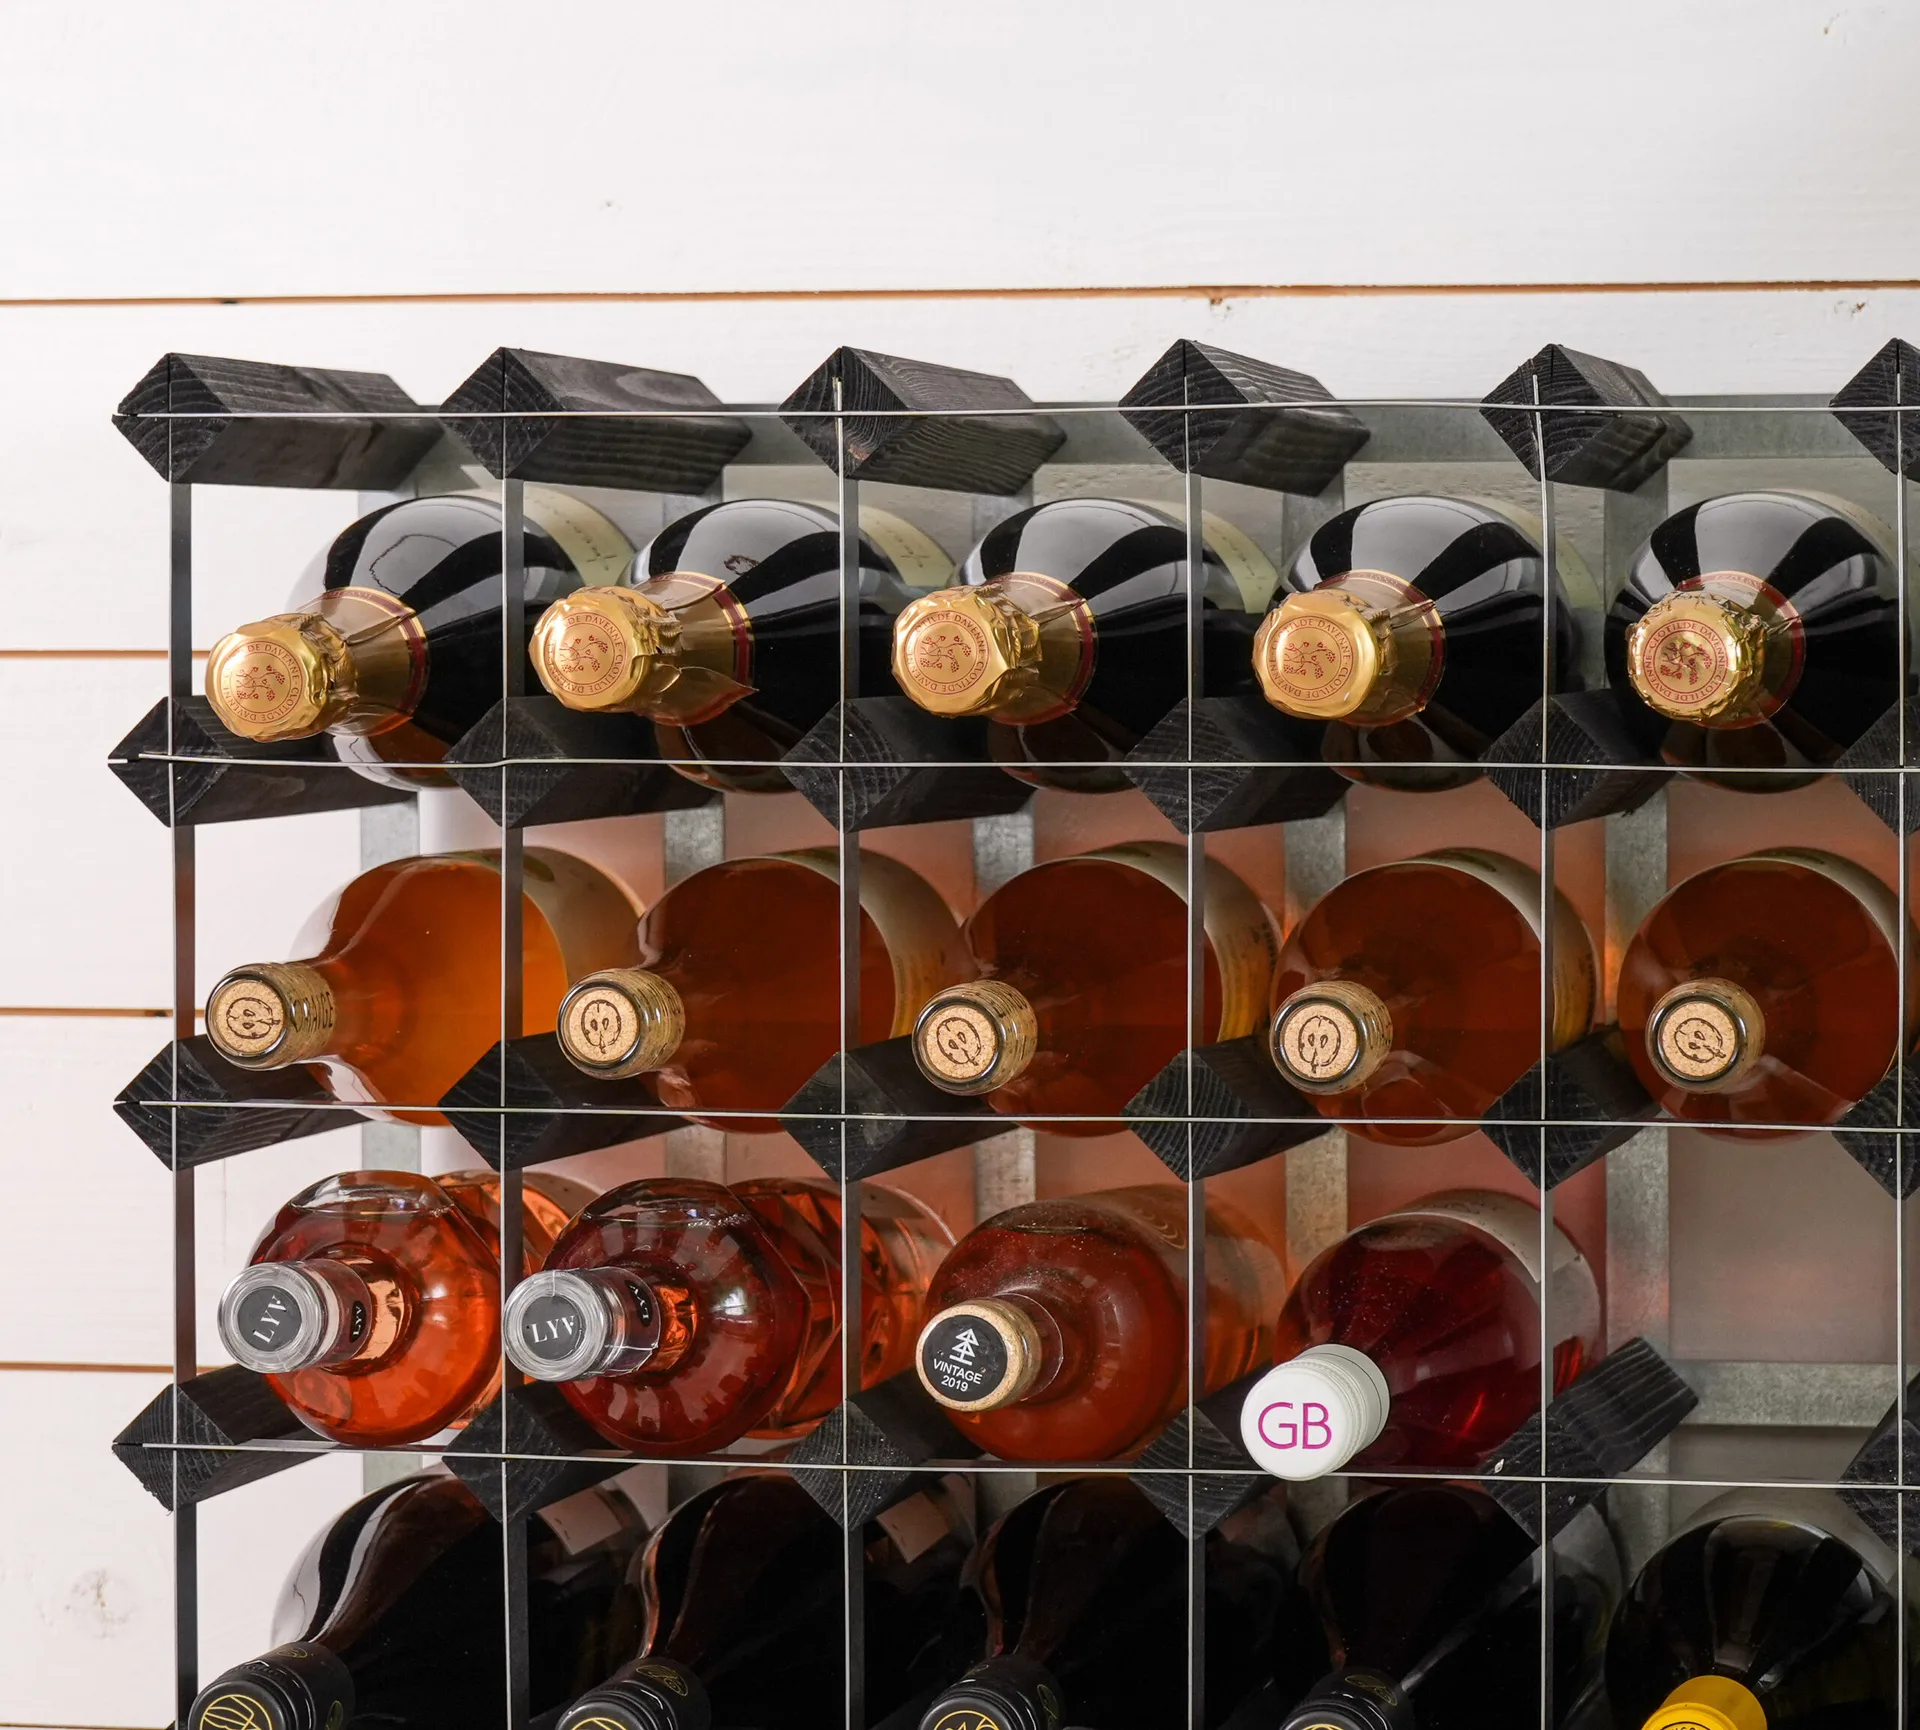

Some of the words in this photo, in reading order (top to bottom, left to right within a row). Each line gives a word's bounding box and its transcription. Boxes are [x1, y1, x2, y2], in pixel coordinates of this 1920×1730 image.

[585, 614, 623, 647] DAVENNE
[953, 613, 987, 653] DAVENNE
[1316, 618, 1350, 659] DAVENNE
[1648, 621, 1697, 650] CLOTILDE
[1698, 624, 1726, 669] DAVENNE
[264, 643, 300, 680] DAVENNE
[587, 653, 624, 692] CLOTILDE
[940, 660, 985, 692] CLOTILDE
[1268, 658, 1302, 698] DAVENNE
[1645, 654, 1672, 697] DAVENNE
[1305, 665, 1349, 699] CLOTILDE
[1672, 672, 1723, 701] CLOTILDE
[260, 685, 299, 721] CLOTILDE
[933, 1358, 983, 1385] VINTAGE
[941, 1375, 969, 1392] 2019
[1258, 1401, 1332, 1450] GB
